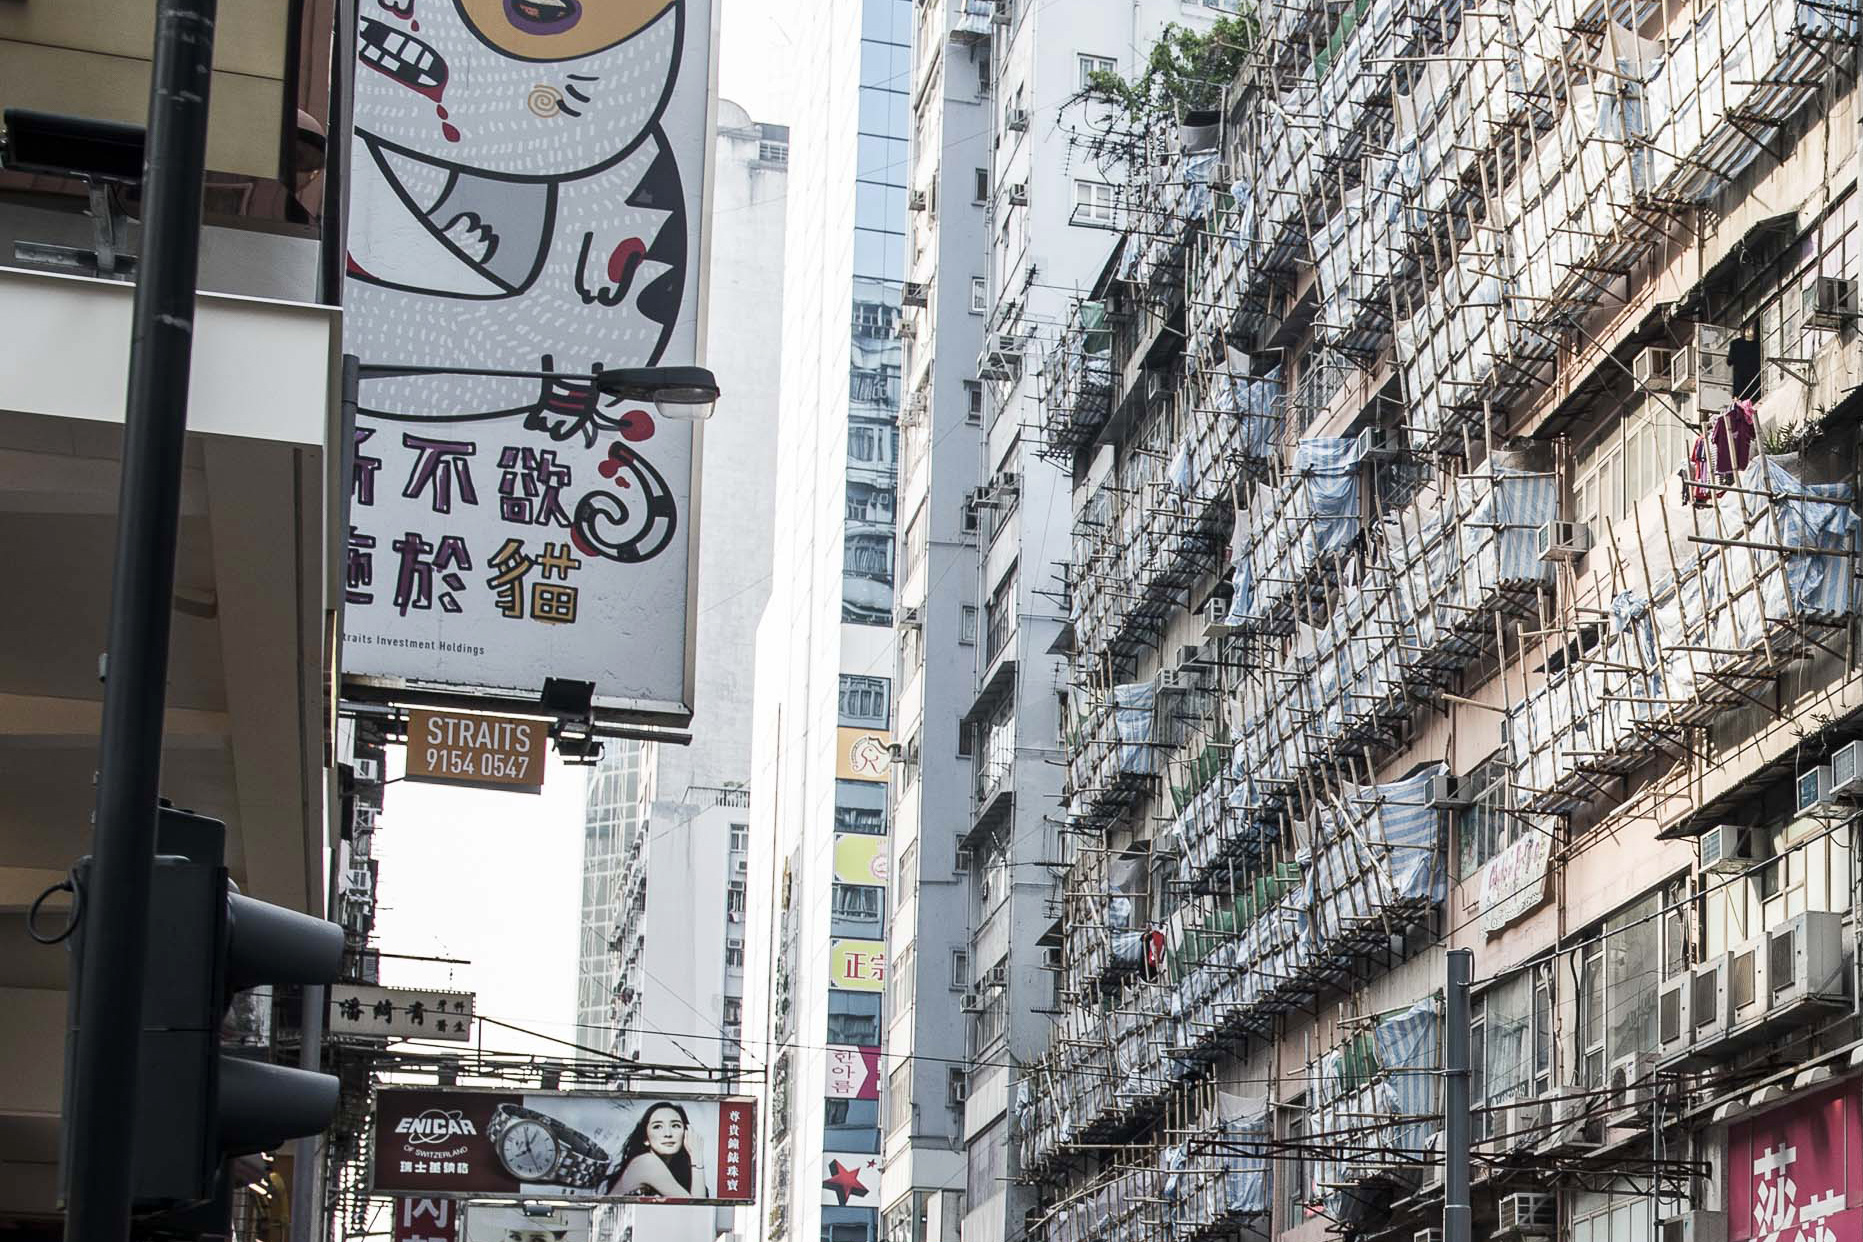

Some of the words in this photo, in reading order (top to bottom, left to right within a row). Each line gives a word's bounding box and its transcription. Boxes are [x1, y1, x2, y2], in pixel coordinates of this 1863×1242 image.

[343, 633, 372, 646] traits
[376, 635, 435, 651] Investment
[439, 640, 485, 657] Holdings
[427, 717, 530, 752] STRAITS
[426, 750, 474, 775] 9154
[481, 753, 529, 780] 0547
[395, 1118, 477, 1136] ENICAR
[404, 1144, 414, 1152] OF
[415, 1146, 468, 1159] SWITZERLAND
